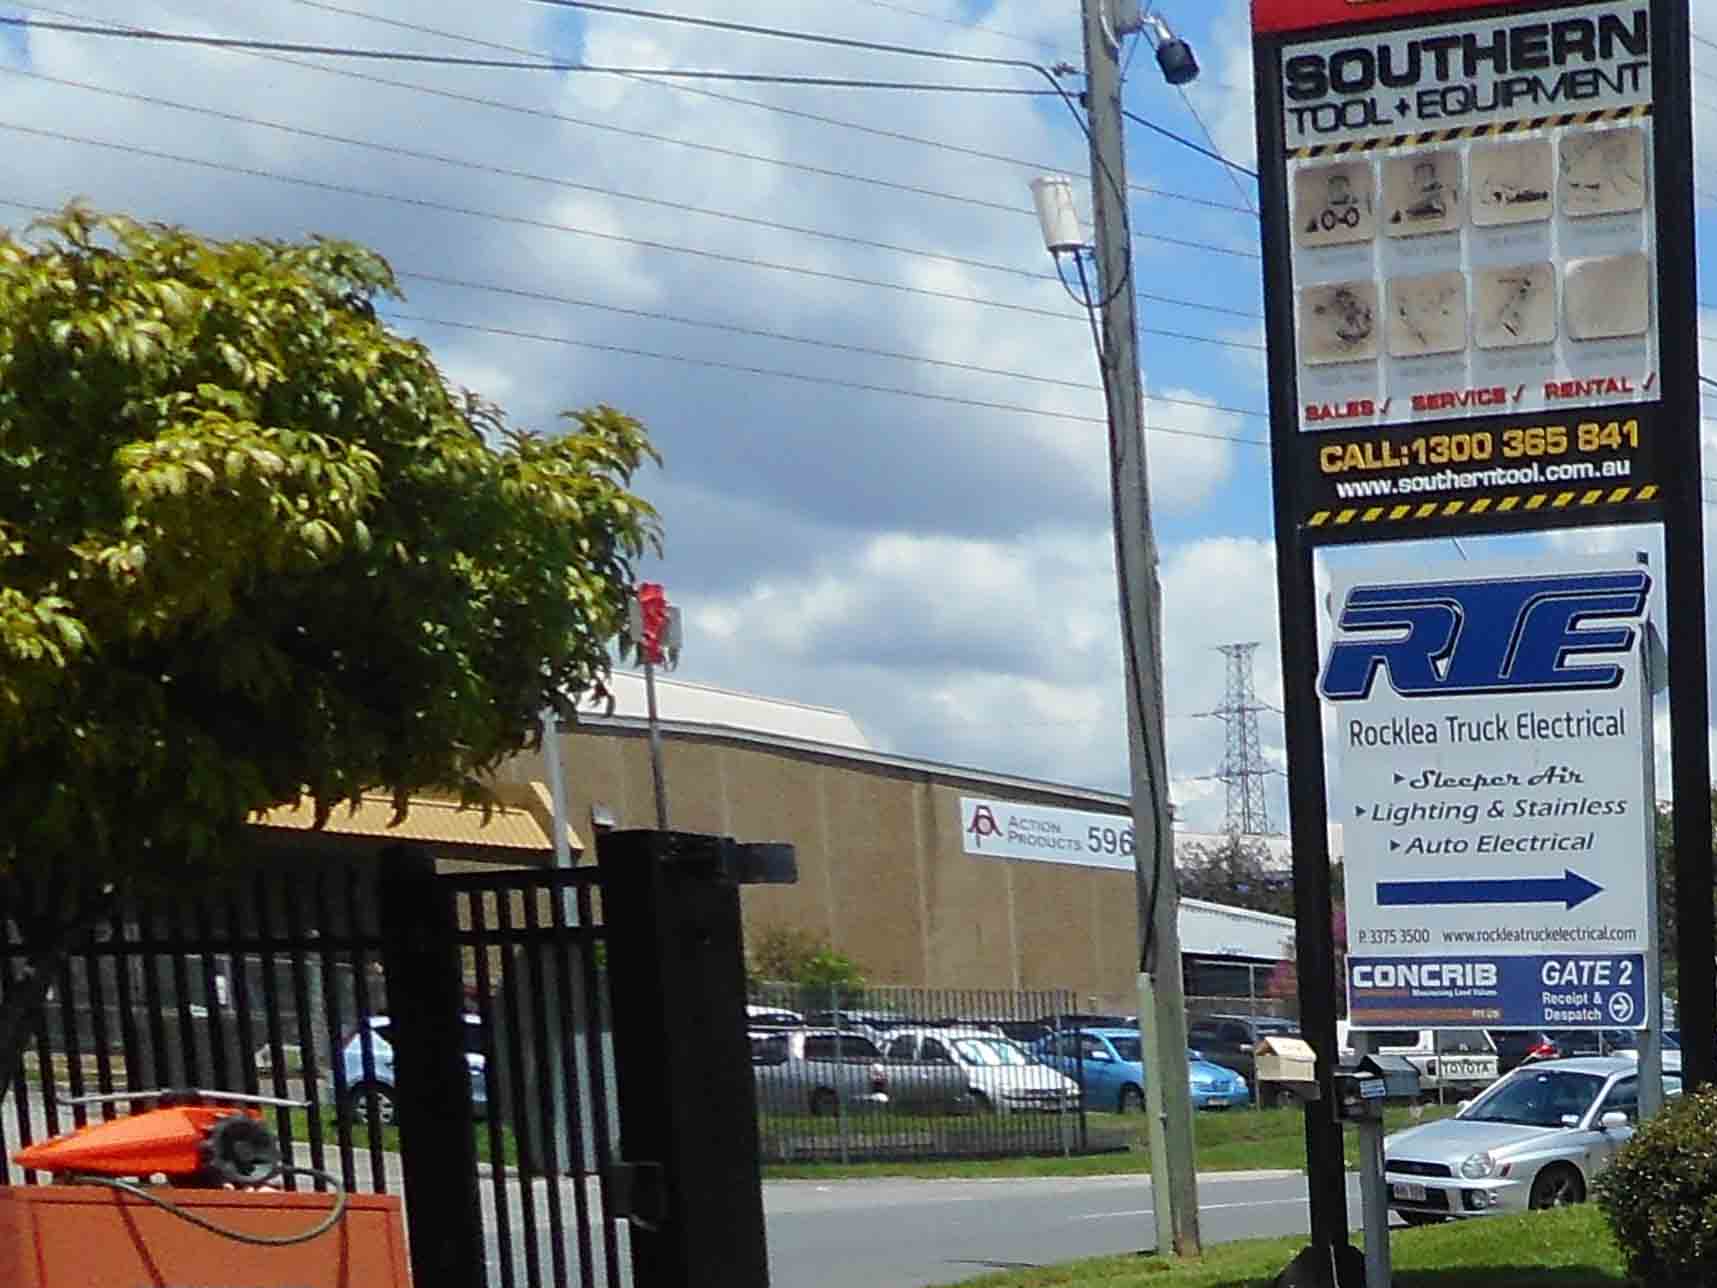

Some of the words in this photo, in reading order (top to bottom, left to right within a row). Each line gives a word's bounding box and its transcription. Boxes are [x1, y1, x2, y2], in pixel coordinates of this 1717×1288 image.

[1285, 9, 1649, 101] SOUTHERN
[1305, 400, 1374, 421] SALES
[1411, 386, 1507, 412] SERVICE
[1544, 376, 1633, 400] RENTAL
[1502, 425, 1568, 459] 365
[1578, 419, 1639, 452] 841
[1337, 458, 1630, 498] www.southerntool.com.au
[1317, 569, 1651, 701] RTE
[1349, 717, 1438, 747] Rocklea
[1445, 713, 1509, 743] Truck
[1516, 708, 1625, 740] Electrical
[1409, 769, 1521, 791] Sleeper
[1528, 765, 1584, 786] Air
[1371, 801, 1479, 827] Lighting
[1487, 800, 1505, 819] &
[1513, 797, 1627, 818] Stainless
[1404, 837, 1468, 855] Auto
[1476, 832, 1595, 853] Electrical
[1353, 964, 1498, 987] CONCRIB
[1541, 961, 1612, 986] GATE
[1618, 960, 1633, 985] 2
[1542, 992, 1589, 1007] Receipt
[1544, 1006, 1602, 1022] Despatch
